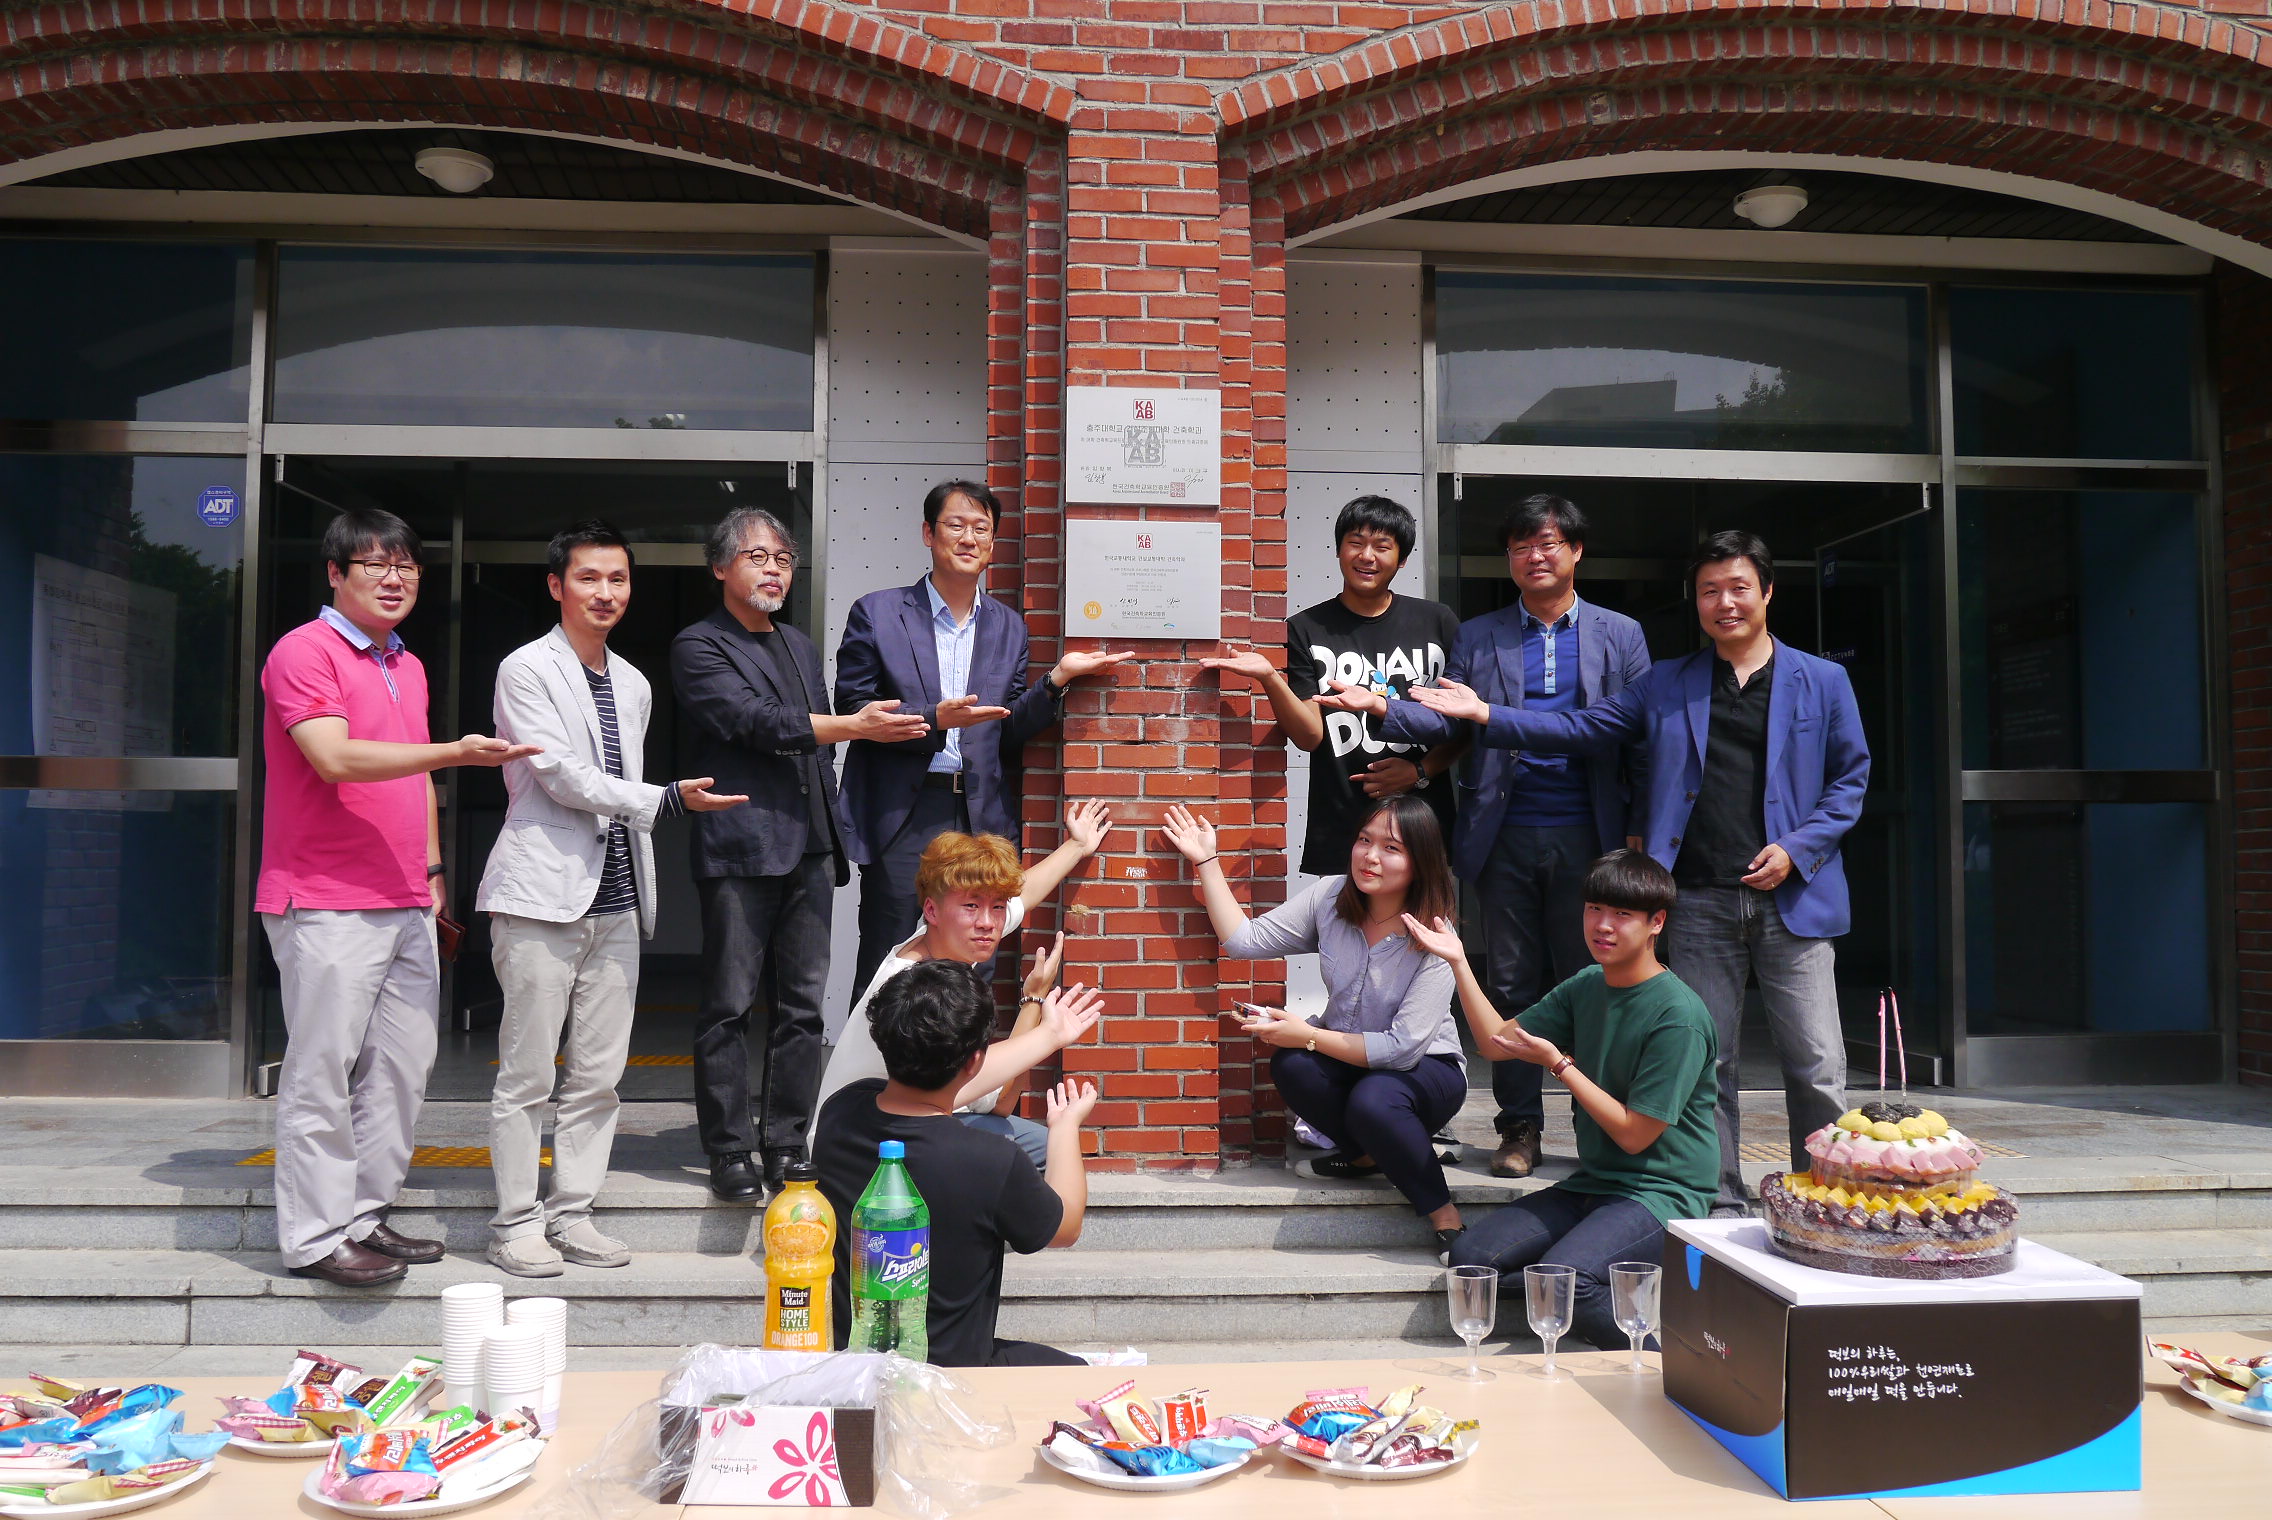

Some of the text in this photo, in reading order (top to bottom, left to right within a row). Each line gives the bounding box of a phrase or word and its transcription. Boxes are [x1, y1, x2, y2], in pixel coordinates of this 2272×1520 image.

[204, 499, 233, 513] ADT
[1309, 642, 1446, 695] DONALD
[1326, 710, 1429, 758] DU
[781, 1289, 809, 1298] Minute
[784, 1297, 804, 1306] Maid
[780, 1308, 809, 1319] HOME
[780, 1319, 809, 1328] STYLE
[772, 1331, 818, 1347] ORANGE100
[1828, 1346, 1861, 1362] 떡보의
[1828, 1362, 1975, 1381] 100%우리쌀과 천연재료로
[1828, 1380, 1963, 1402] 매일매일 떡을 만듭니다.
